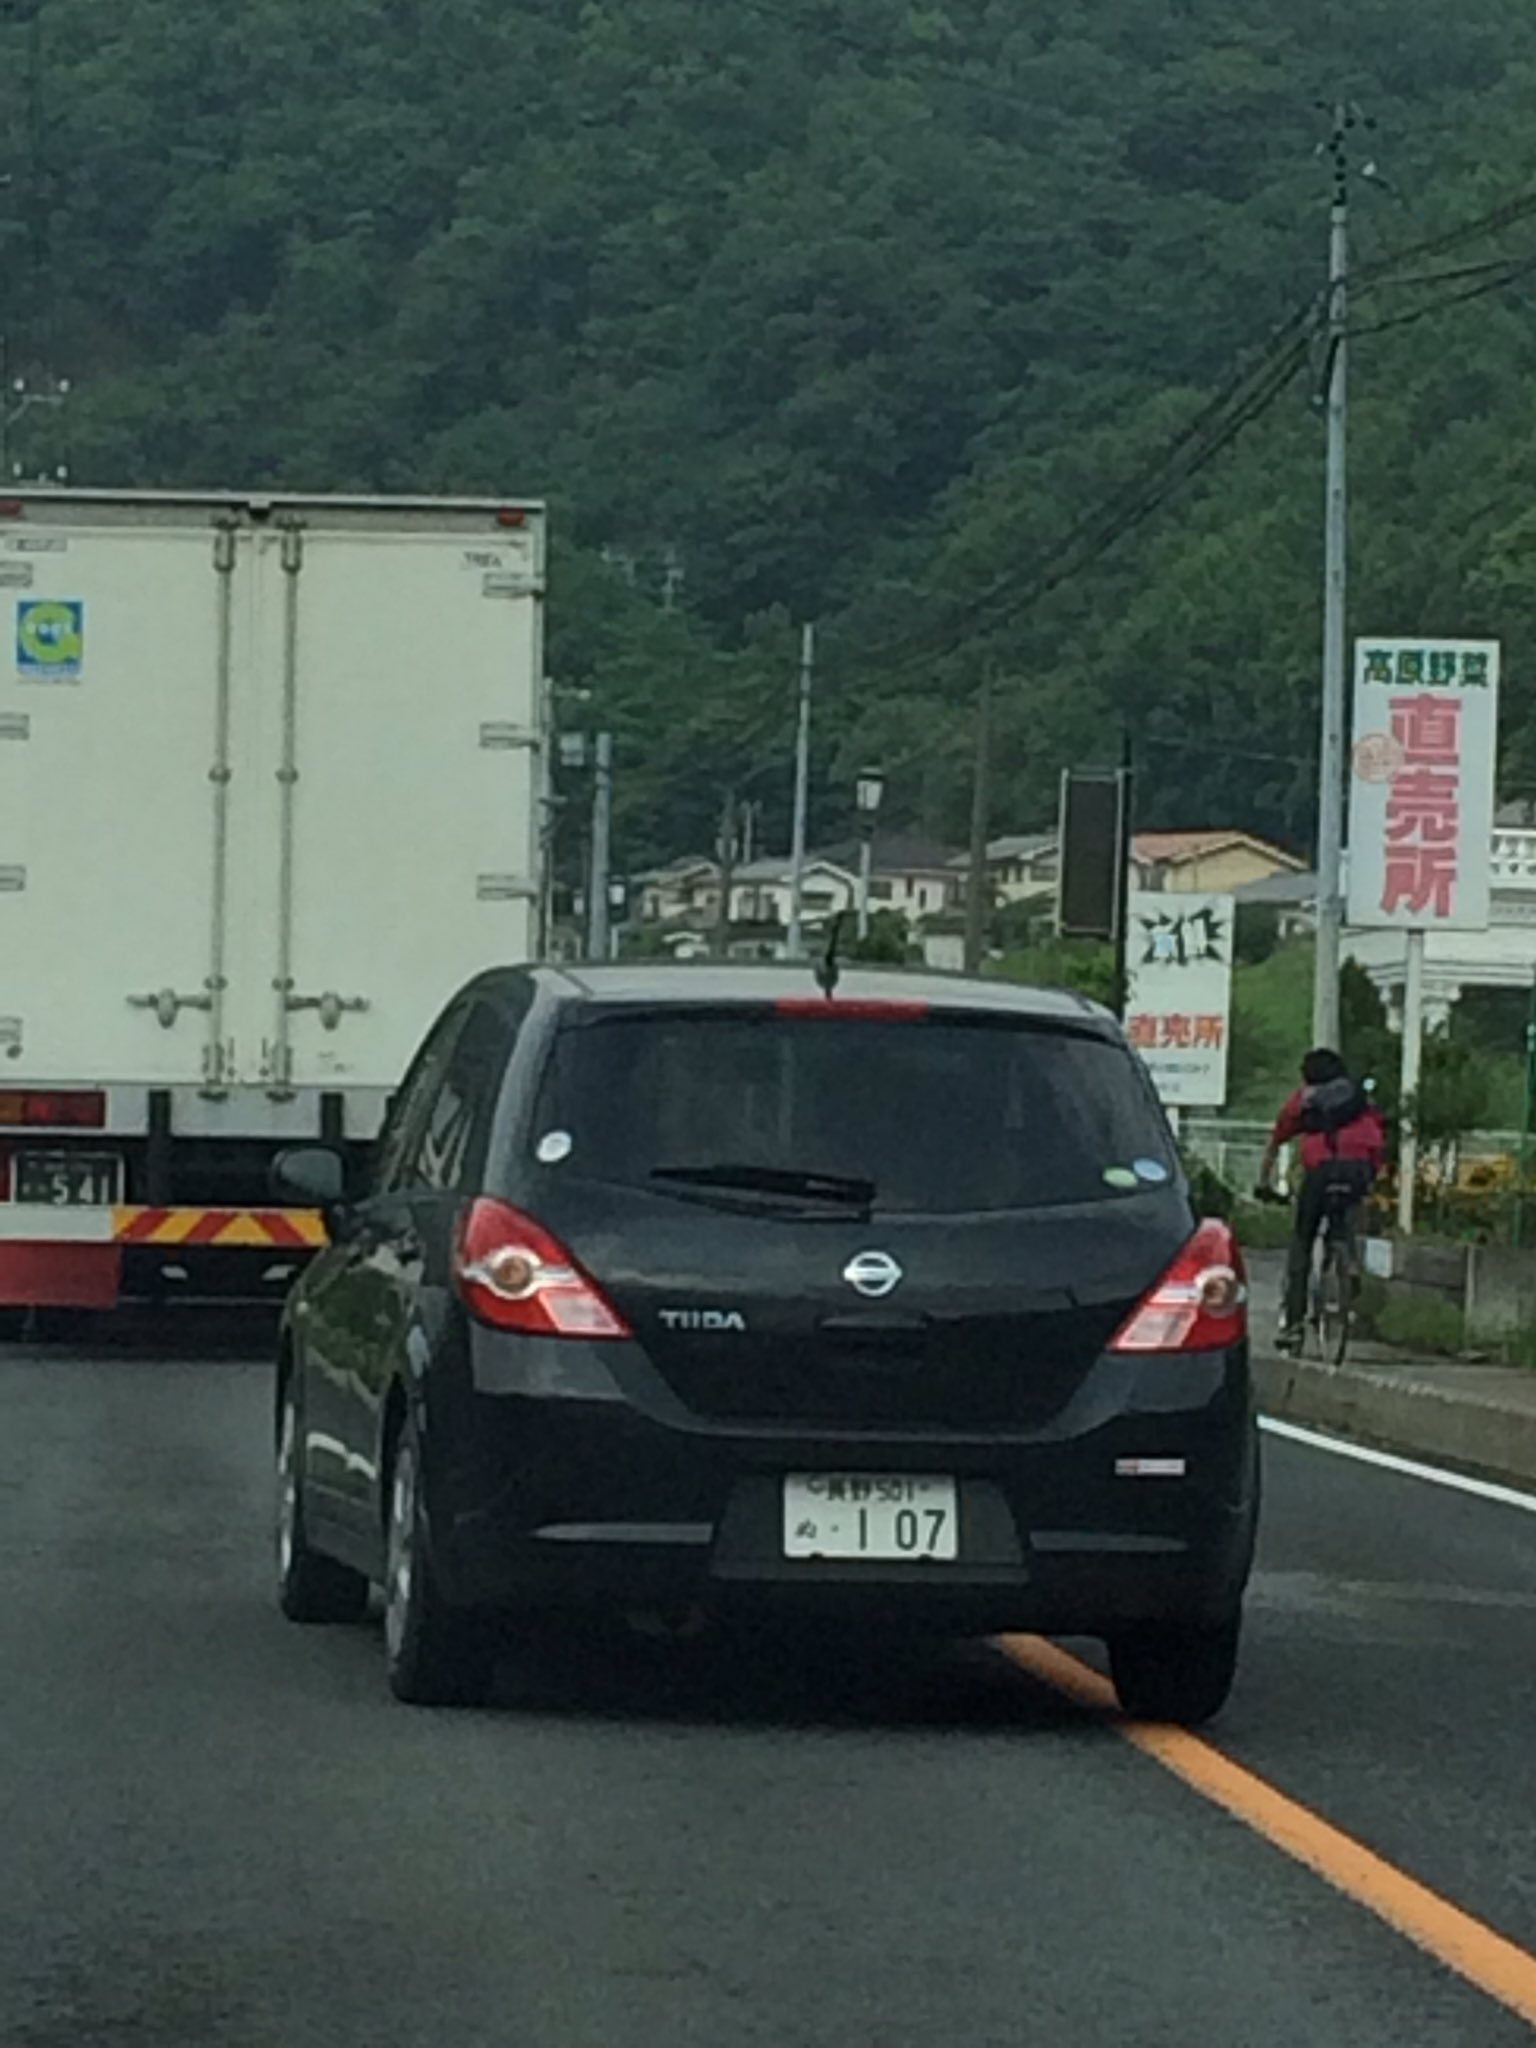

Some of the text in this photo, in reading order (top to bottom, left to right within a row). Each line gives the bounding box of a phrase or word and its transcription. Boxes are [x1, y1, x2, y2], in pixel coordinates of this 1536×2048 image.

[1363, 650, 1489, 687] 高原野菜
[1380, 693, 1462, 917] 直売所
[1129, 1013, 1223, 1051] 直売所
[658, 1309, 745, 1331] TIIDA
